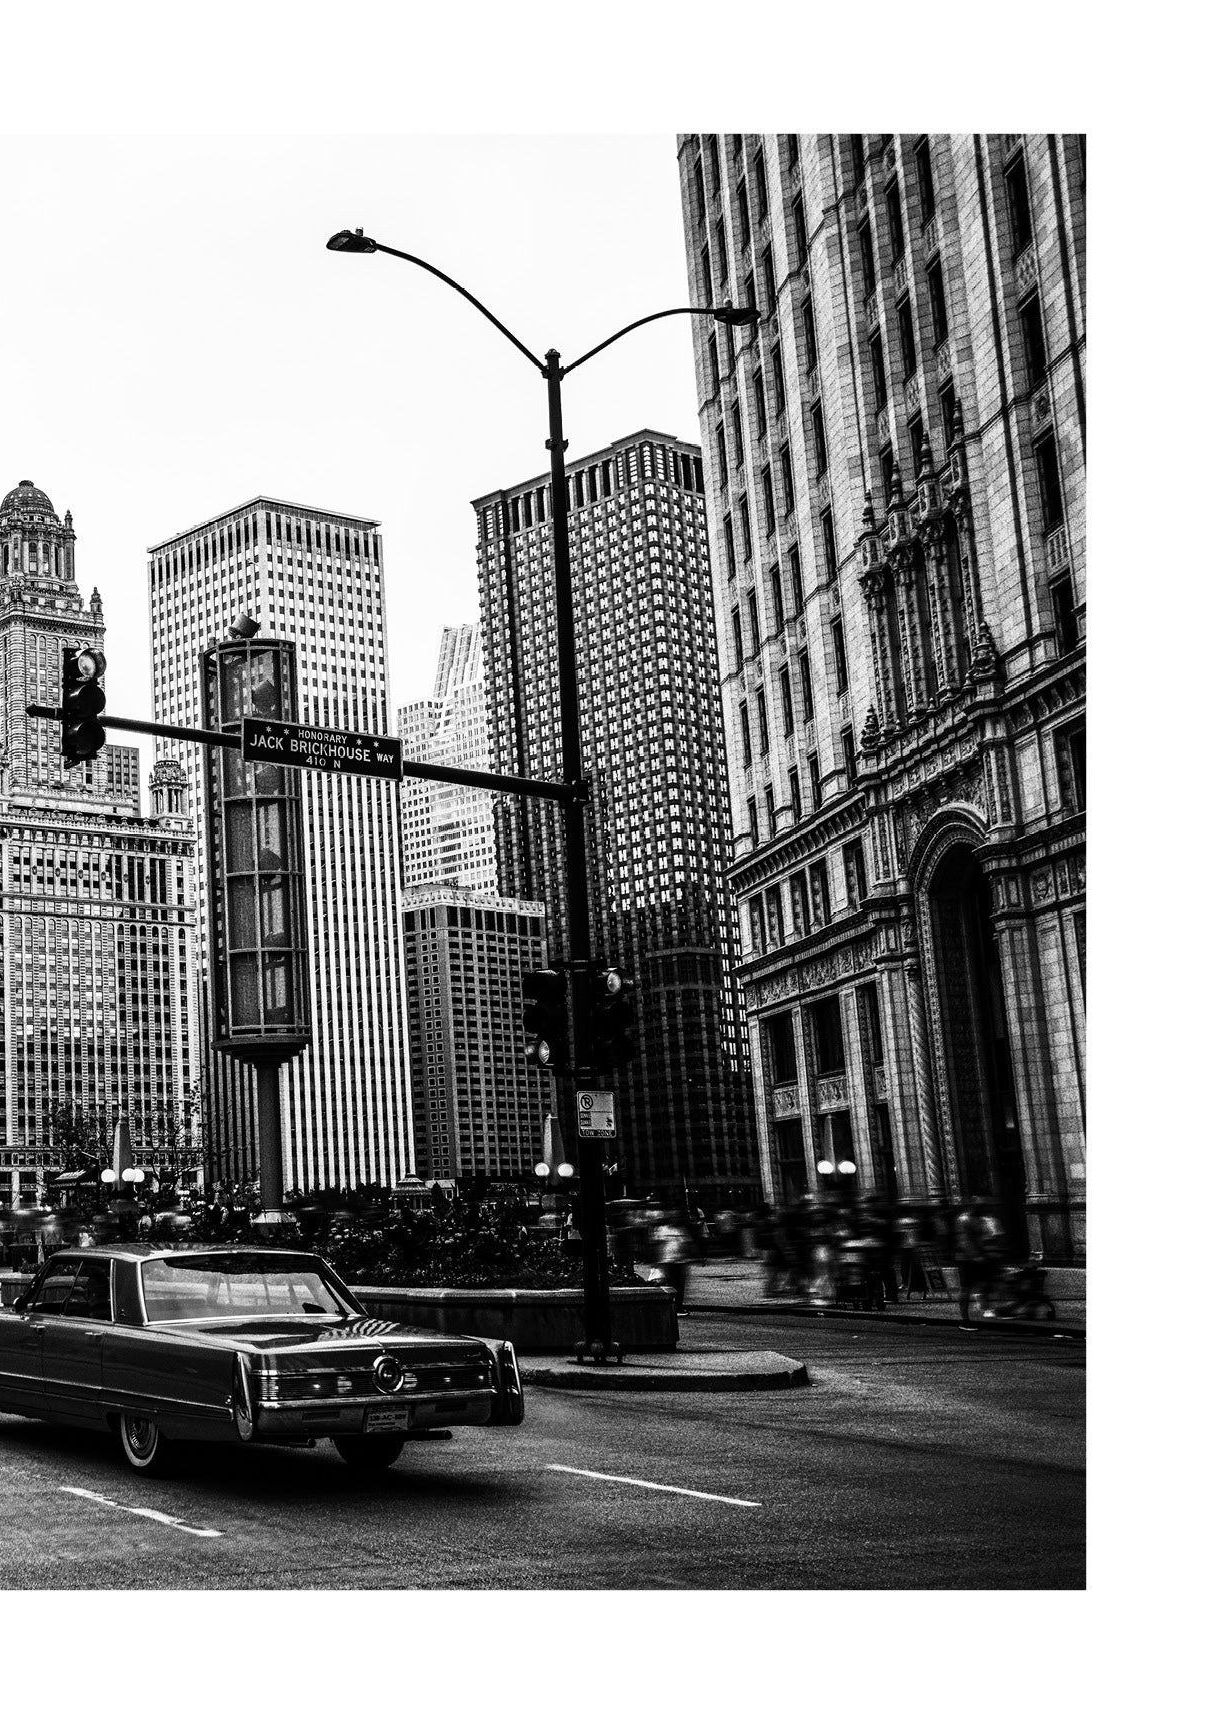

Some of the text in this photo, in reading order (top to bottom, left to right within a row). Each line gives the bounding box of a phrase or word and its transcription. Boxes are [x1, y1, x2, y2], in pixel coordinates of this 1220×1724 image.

[298, 729, 348, 745] HONORARY
[250, 733, 394, 764] JACK BRICKHOUSE WAY
[306, 755, 341, 769] 410 N
